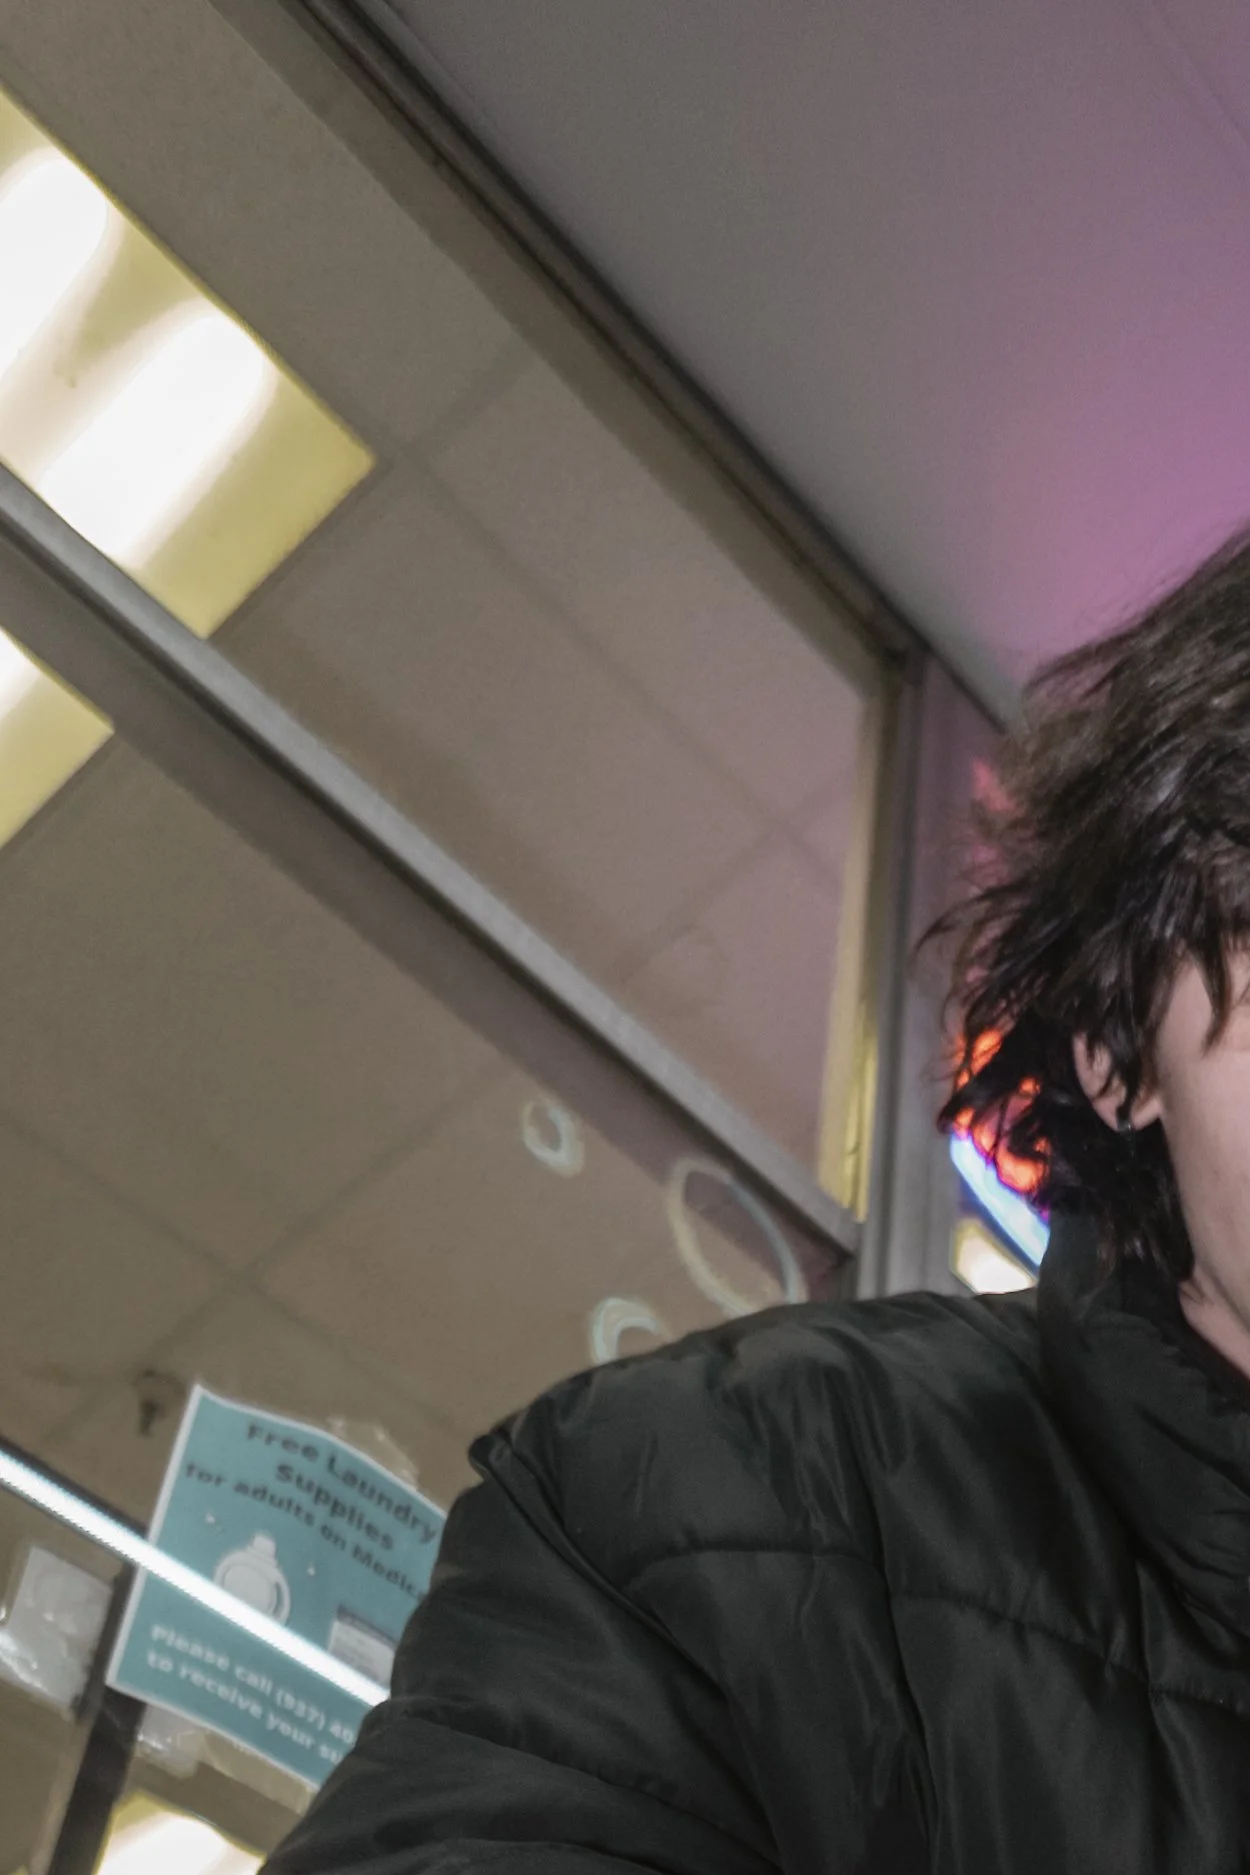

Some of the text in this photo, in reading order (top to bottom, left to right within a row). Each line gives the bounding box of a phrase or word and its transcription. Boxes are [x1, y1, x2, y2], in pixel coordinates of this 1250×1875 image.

[186, 1462, 227, 1488] for
[234, 1481, 315, 1528] adults
[320, 1524, 346, 1551] on
[246, 1423, 437, 1545] Free Laundry
[275, 1462, 394, 1551] Supplies
[147, 1648, 174, 1673] to
[179, 1663, 263, 1720] receive
[265, 1711, 315, 1751] your
[151, 1622, 230, 1672] Please
[234, 1664, 273, 1697] call
